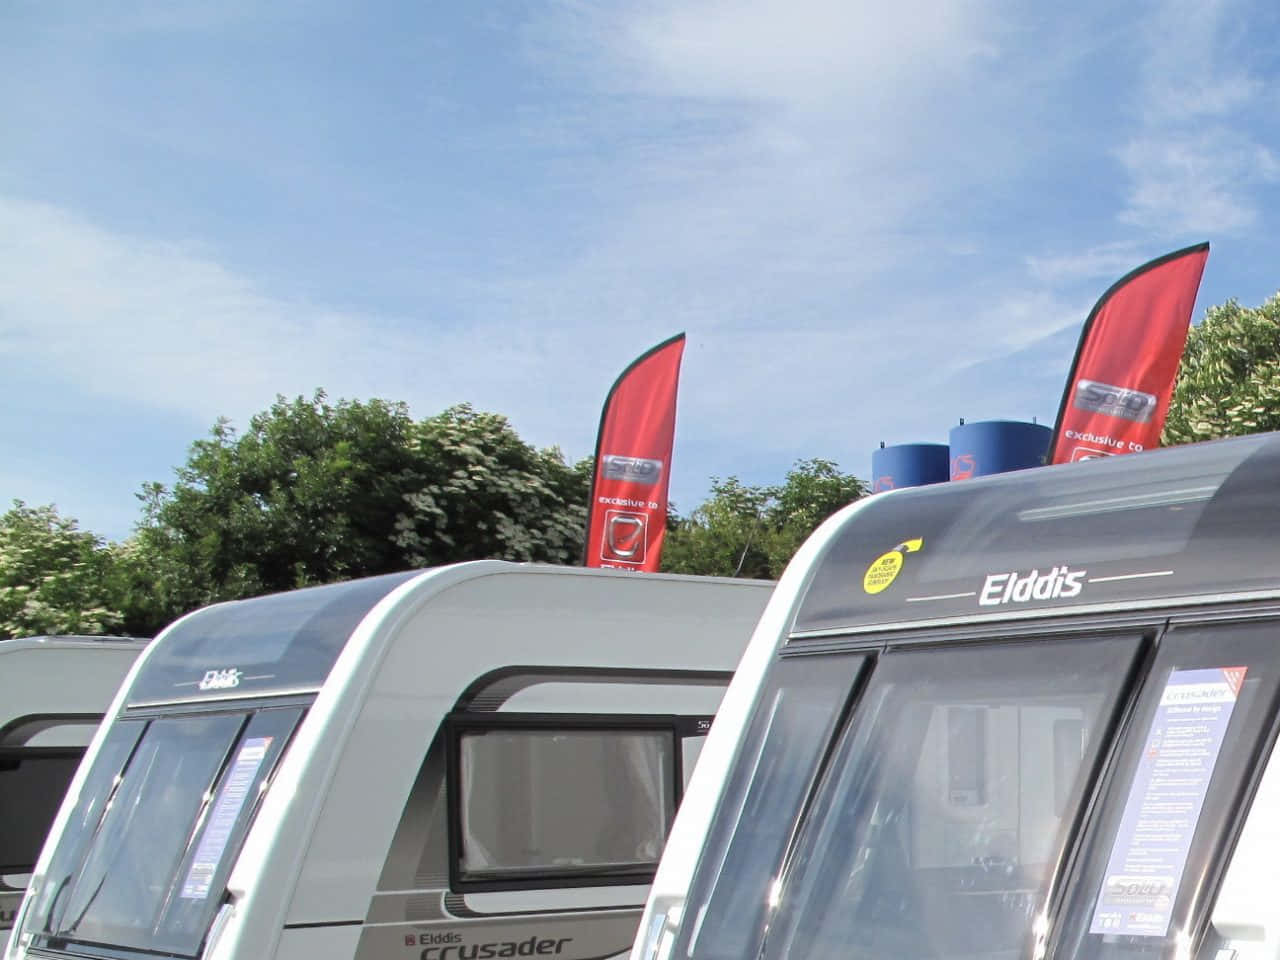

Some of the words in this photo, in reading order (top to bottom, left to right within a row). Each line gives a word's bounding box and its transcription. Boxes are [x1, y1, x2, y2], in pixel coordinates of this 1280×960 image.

[1065, 430, 1125, 448] exclusive
[1128, 441, 1144, 452] to
[598, 496, 645, 508] exclusive
[648, 501, 658, 509] to
[979, 566, 1087, 605] Elddis
[419, 932, 463, 945] Elddis
